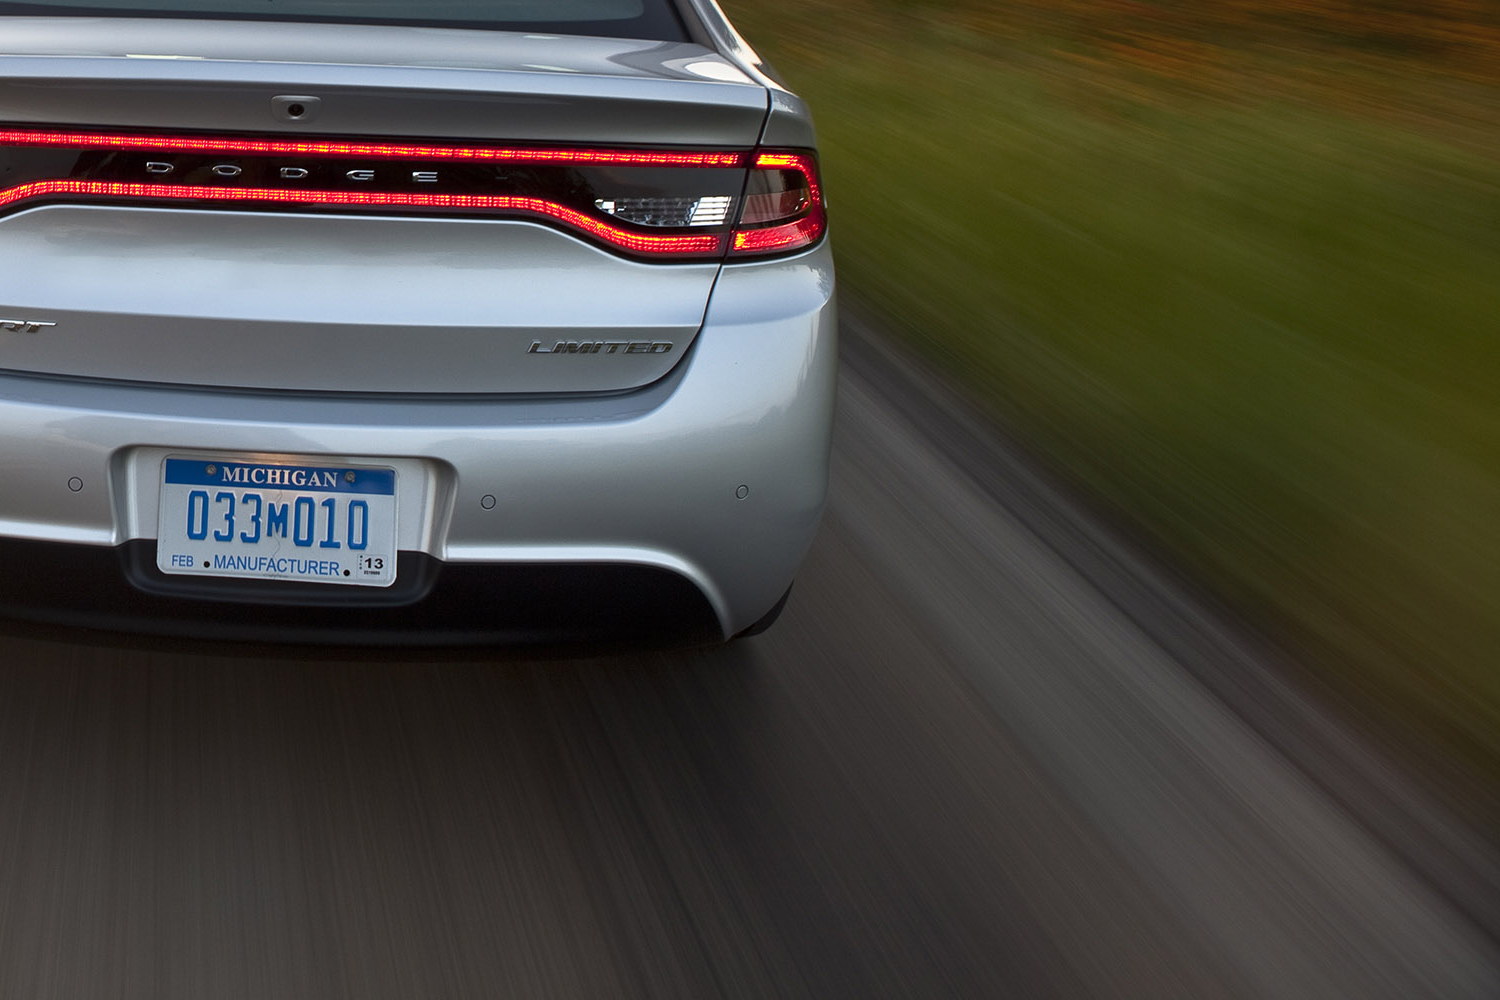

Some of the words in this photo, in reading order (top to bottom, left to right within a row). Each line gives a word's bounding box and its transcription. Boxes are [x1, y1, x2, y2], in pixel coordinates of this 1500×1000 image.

[146, 161, 438, 182] DODGE
[527, 339, 674, 354] LIMITED
[222, 466, 338, 488] MICHIGAN
[187, 490, 369, 550] 033M010
[171, 554, 194, 567] FEB
[214, 554, 340, 576] MANUFACTURER
[364, 557, 384, 570] 13
